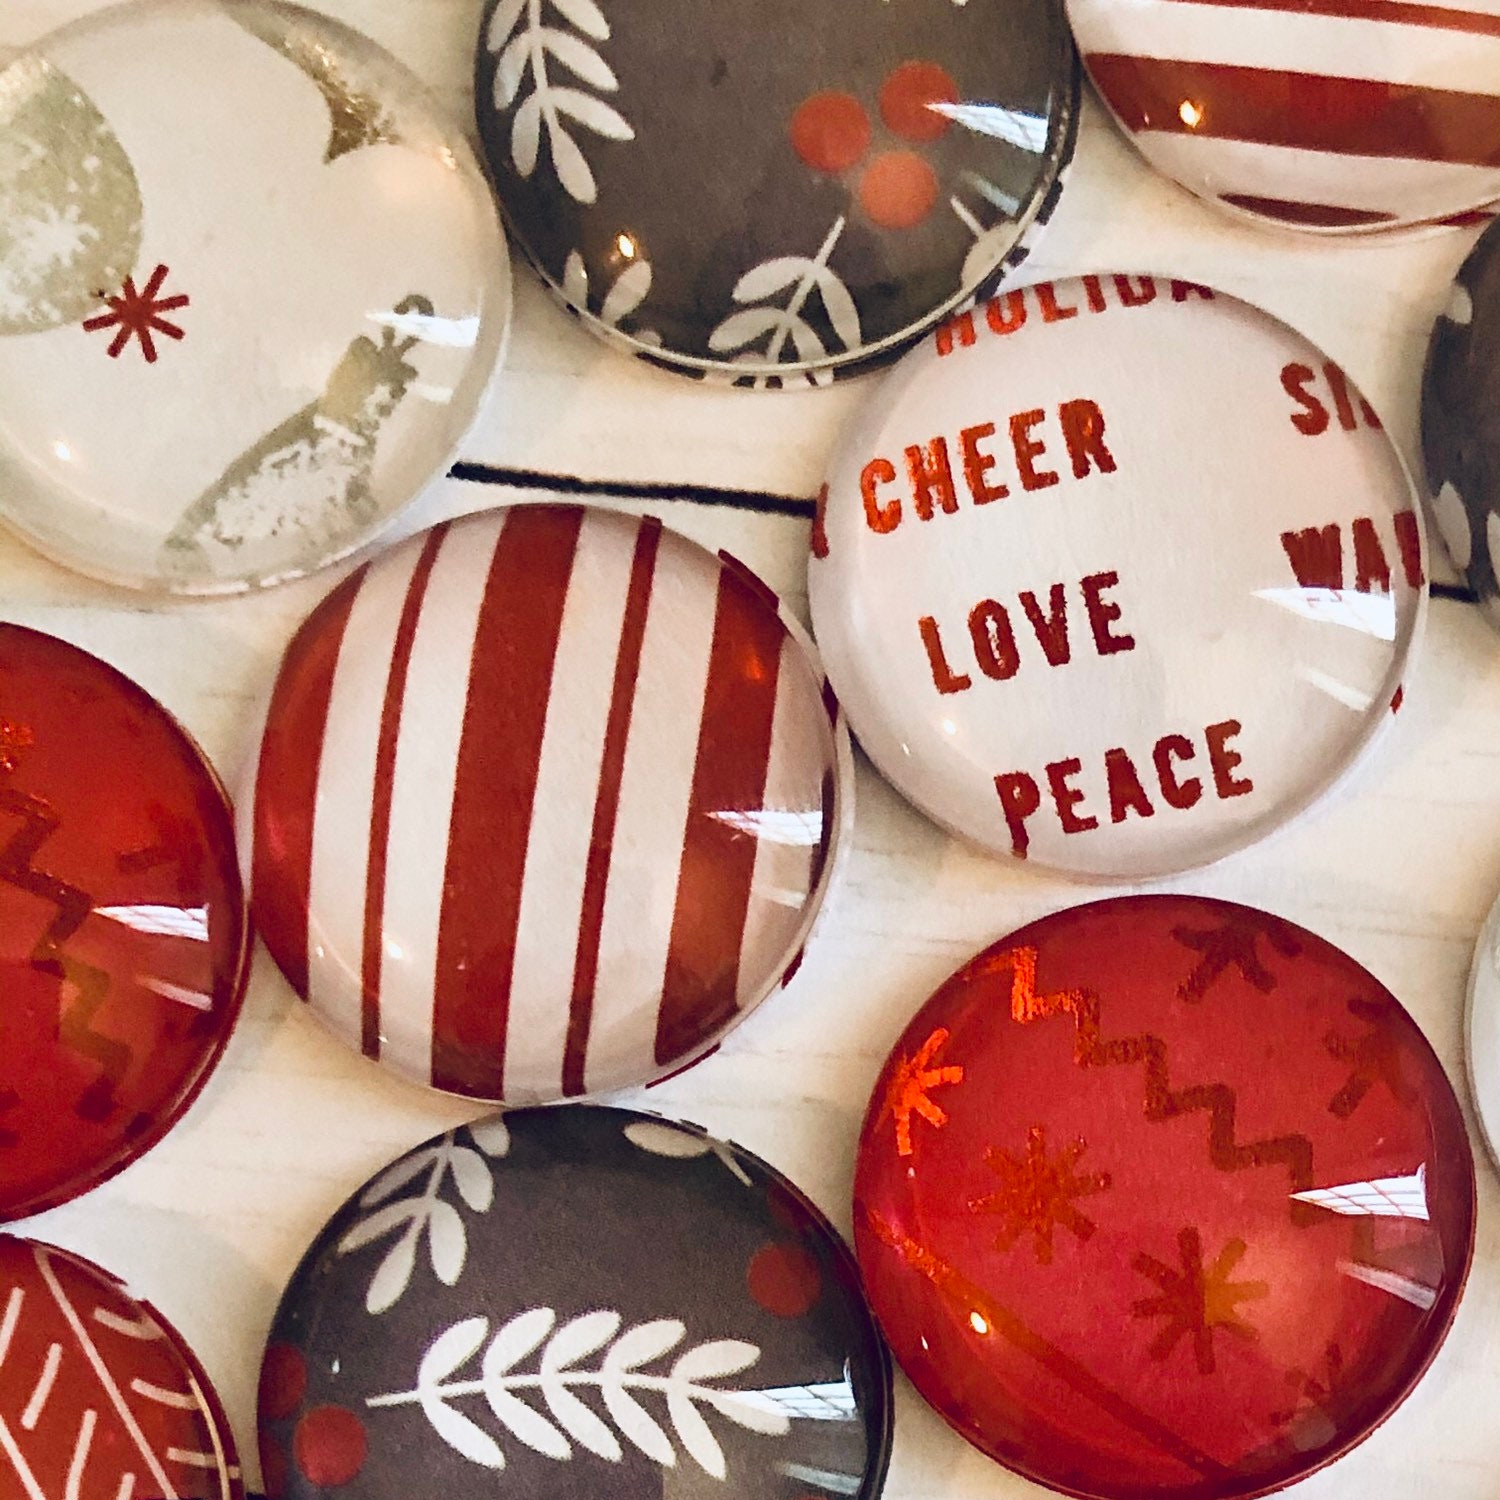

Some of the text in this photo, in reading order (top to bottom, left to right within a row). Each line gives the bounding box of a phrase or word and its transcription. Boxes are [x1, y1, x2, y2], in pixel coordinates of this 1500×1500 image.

[860, 398, 1117, 535] CHEER
[917, 570, 1136, 695] LOVE
[993, 718, 1254, 860] PEACE
